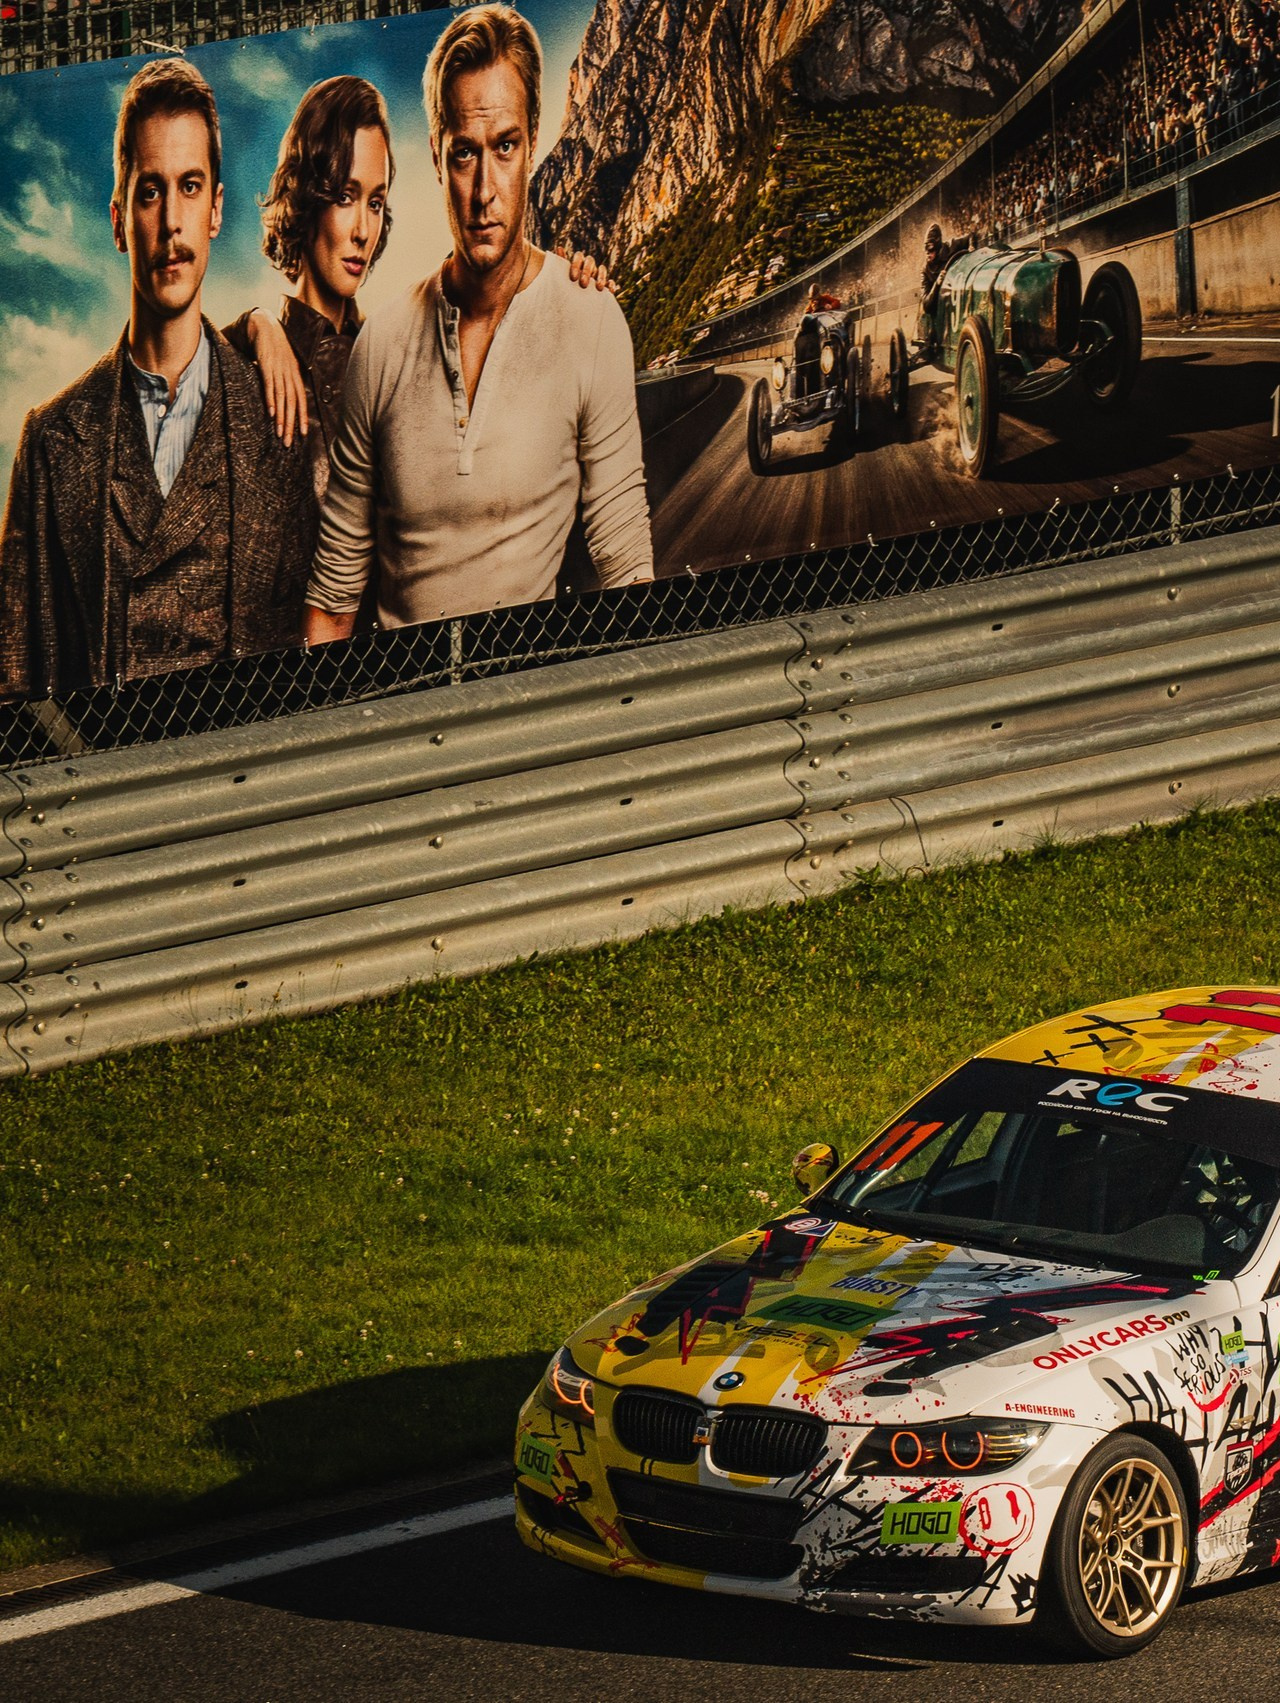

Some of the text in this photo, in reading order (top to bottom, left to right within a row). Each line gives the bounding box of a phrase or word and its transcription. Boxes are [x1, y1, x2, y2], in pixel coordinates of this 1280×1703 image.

[852, 1121, 944, 1171] 11
[771, 1300, 877, 1326] HOGO
[1032, 1314, 1168, 1370] ONLYCARS
[1165, 1324, 1210, 1362] WHY
[1224, 1335, 1243, 1349] HOGO
[1191, 1353, 1206, 1374] SO
[1240, 1366, 1252, 1378] TSS
[1005, 1402, 1076, 1419] A-ENGINEERING
[520, 1442, 550, 1475] HOGO
[889, 1510, 952, 1536] HOGO
